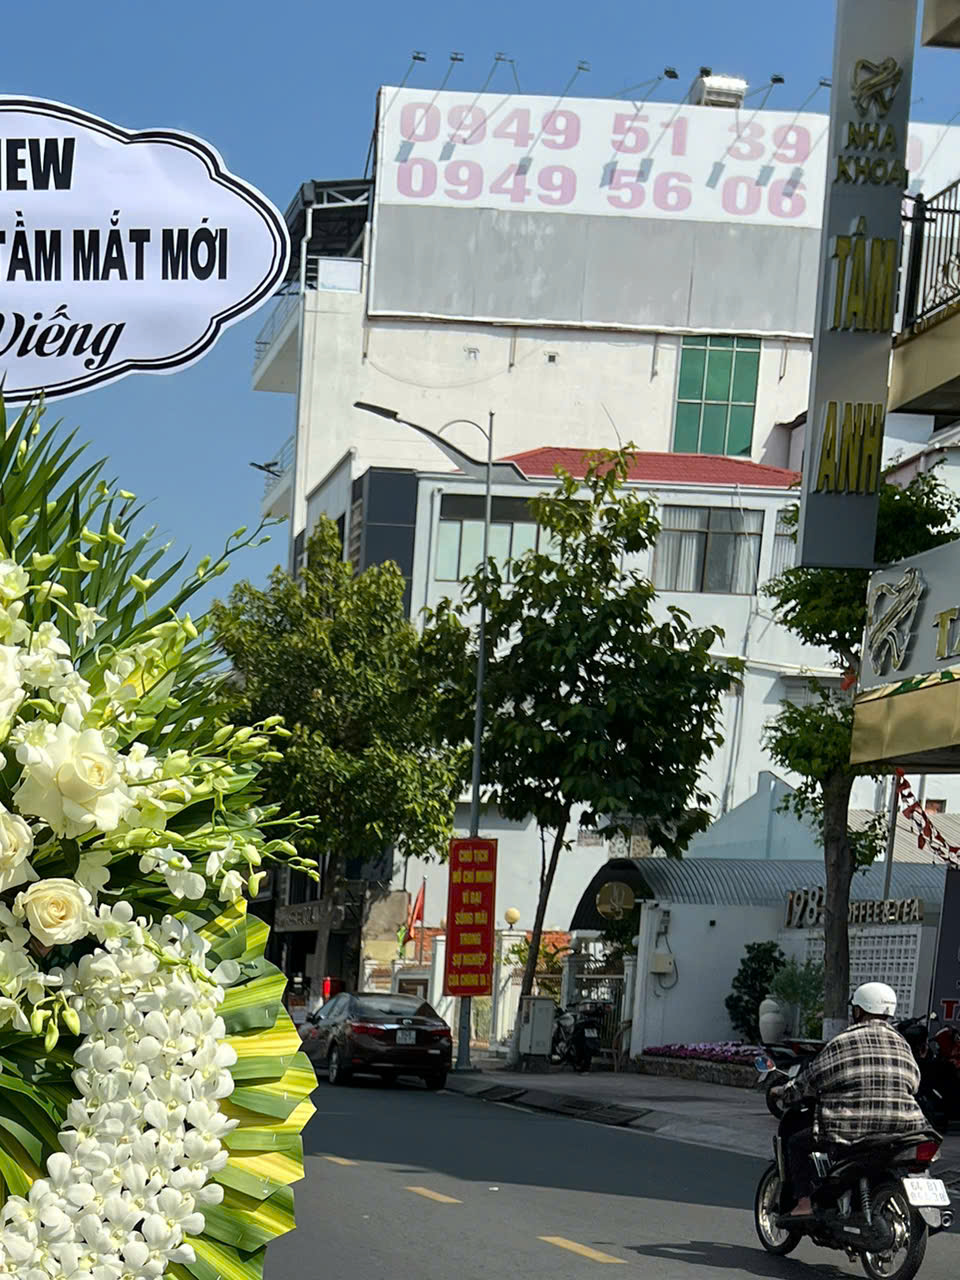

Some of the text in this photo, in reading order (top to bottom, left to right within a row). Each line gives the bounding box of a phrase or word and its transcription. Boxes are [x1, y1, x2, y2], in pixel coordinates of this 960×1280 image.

[398, 102, 811, 164] 0949 51 39
[845, 121, 897, 150] NHA
[396, 158, 807, 218] 0949 56 06
[835, 156, 907, 185] KHOA
[72, 209, 151, 282] MẮT
[161, 217, 228, 281] MỚI
[832, 216, 897, 332] TÂM
[815, 400, 884, 493] ANH
[933, 607, 960, 661] T
